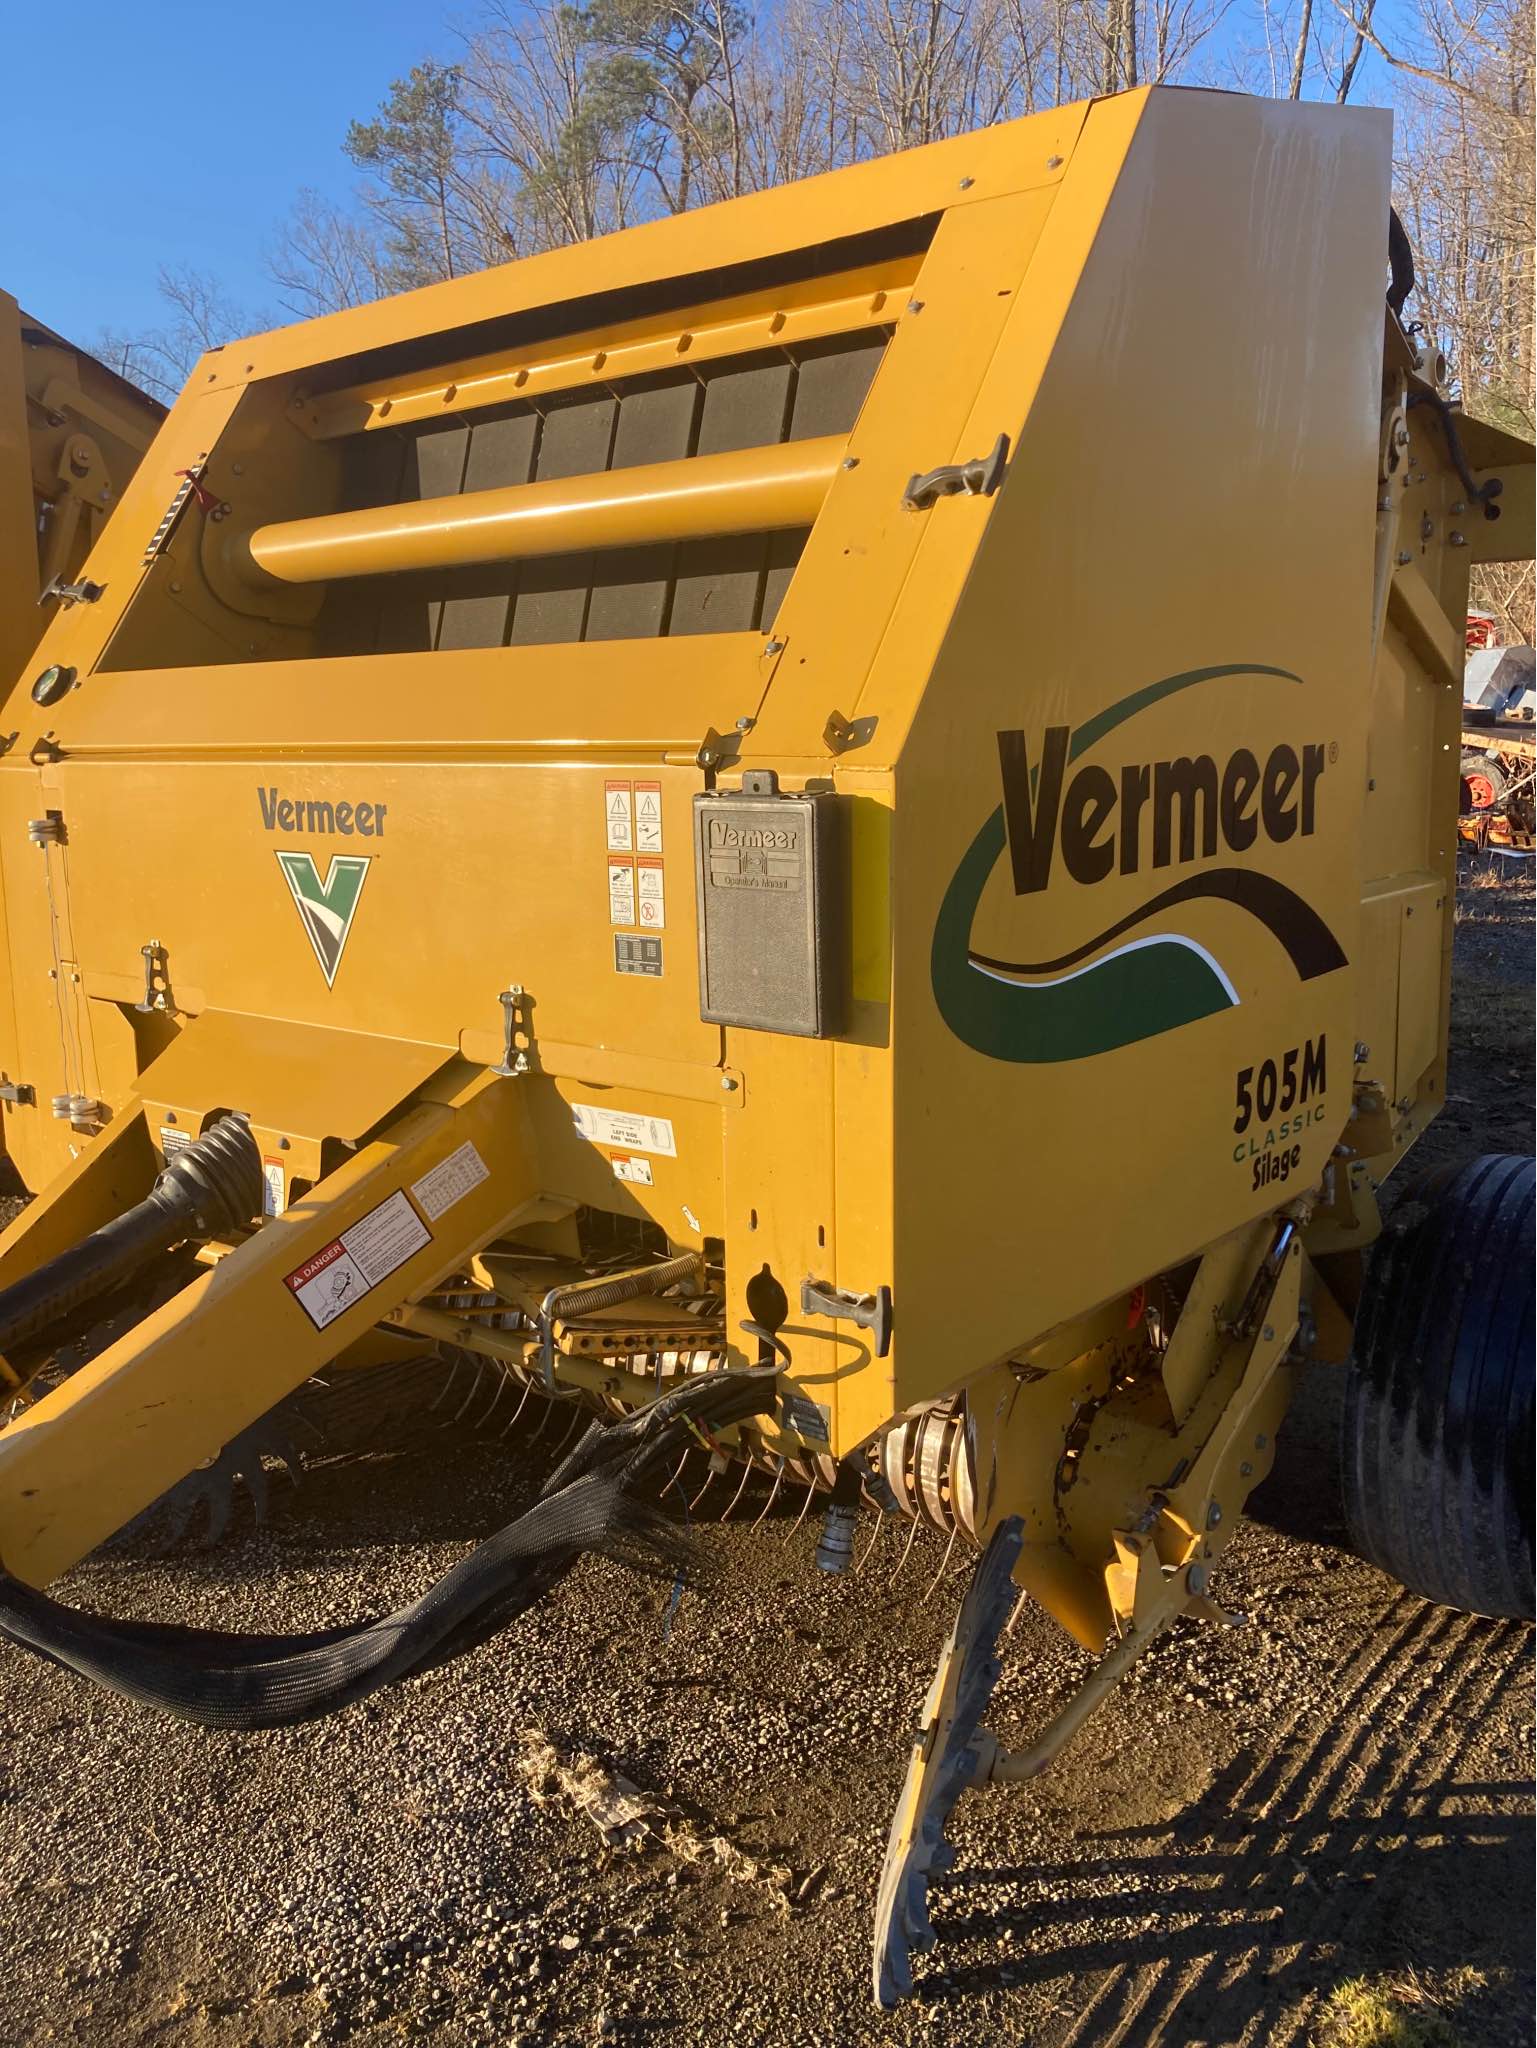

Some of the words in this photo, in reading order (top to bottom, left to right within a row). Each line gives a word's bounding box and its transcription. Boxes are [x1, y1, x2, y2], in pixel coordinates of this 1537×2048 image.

[257, 787, 388, 837] Vermeer
[712, 822, 797, 849] Vermeer
[996, 726, 1325, 896] Vermeer
[724, 876, 759, 888] Operator's
[761, 877, 788, 889] Manual
[1233, 1033, 1327, 1135] 505M
[1232, 1103, 1326, 1164] CLASSIC
[1252, 1142, 1301, 1192] Silage
[303, 1244, 342, 1277] DANGER
